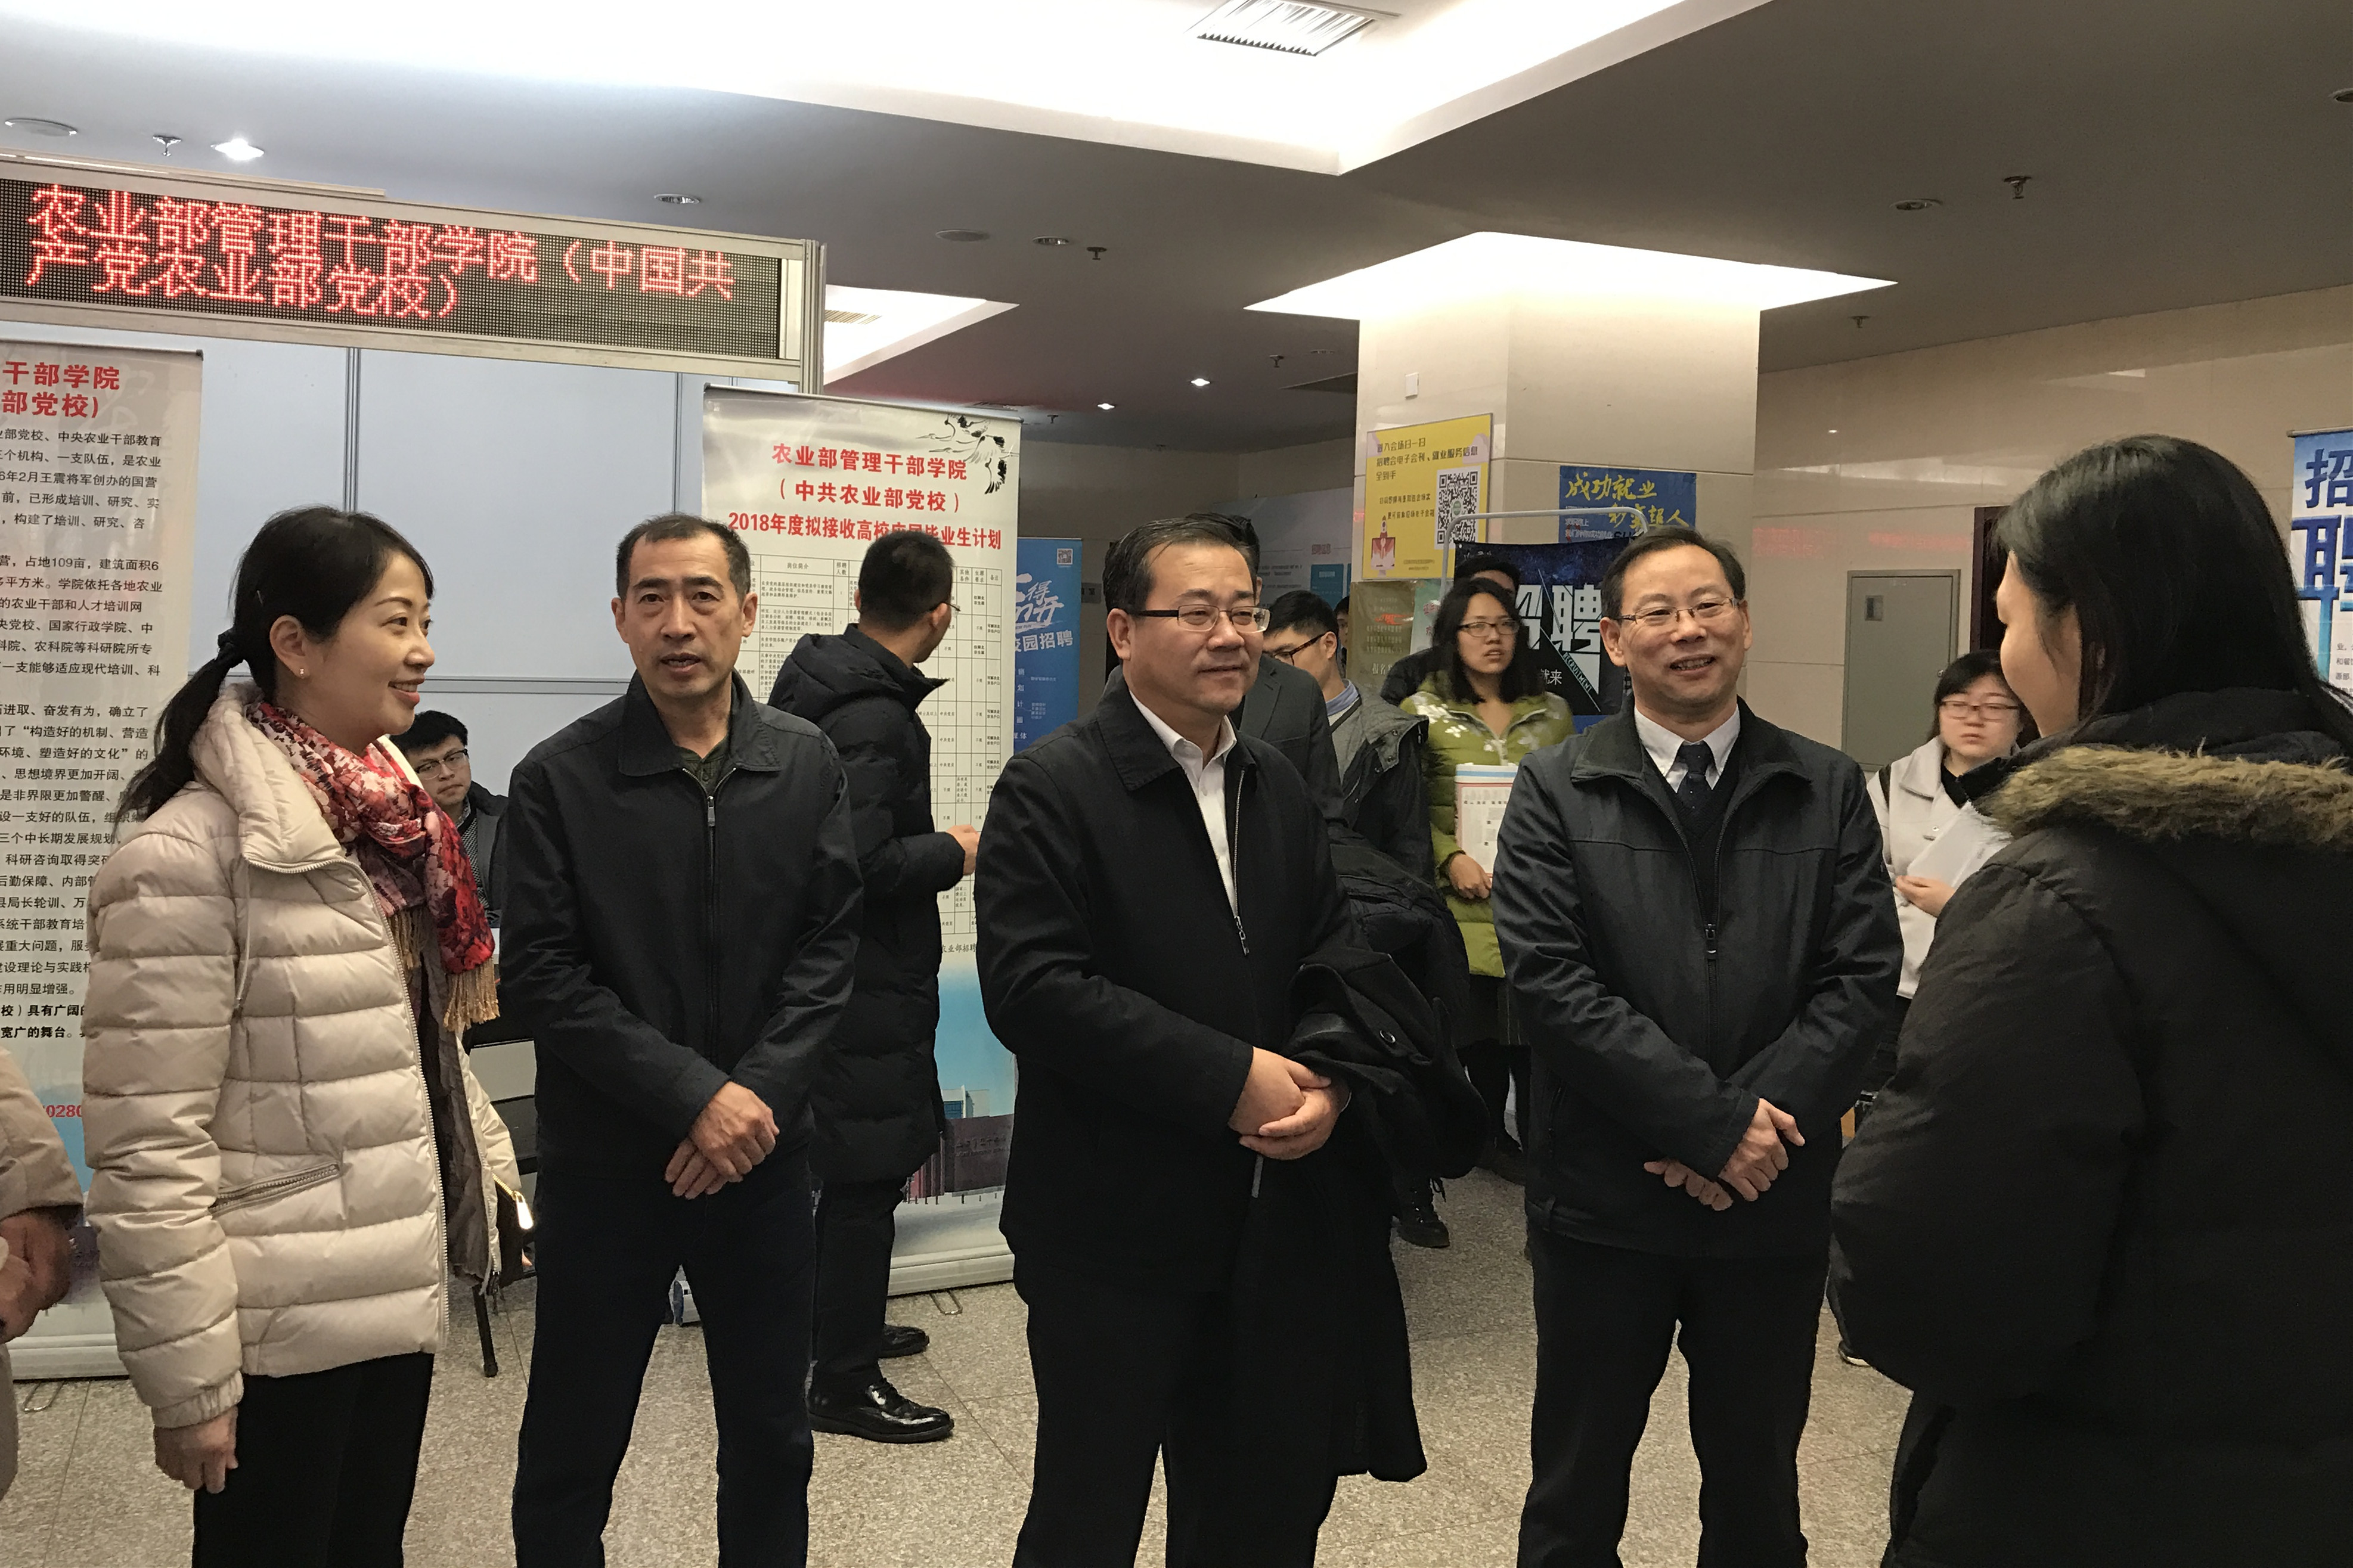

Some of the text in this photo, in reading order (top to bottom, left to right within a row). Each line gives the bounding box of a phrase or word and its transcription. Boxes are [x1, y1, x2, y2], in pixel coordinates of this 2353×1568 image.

[2, 361, 120, 390] 干部学院
[0, 428, 162, 446] 部党校、中央农业干部教育
[0, 449, 161, 467] 个机构、一支队伍，是农业
[772, 443, 967, 480] 农业部管理干部学院
[1565, 471, 1657, 501] 成功就业
[780, 479, 960, 513] （中共农业部党校）
[0, 576, 162, 592] 平方米。学院依托各地农业
[0, 661, 160, 676] 一支能够适应现代培训、科
[1563, 652, 1592, 693] RECRUITMENT
[0, 704, 148, 717] 进取、奋发有为，确立了
[0, 725, 148, 739] 了“构造好的机制、营造
[0, 918, 87, 930] 统干部教育培
[0, 940, 89, 952] 重大问题，服
[0, 961, 91, 973] 设理论与实践
[0, 983, 74, 995] 用明显增强。
[1, 1005, 84, 1016] 校）具有广阔
